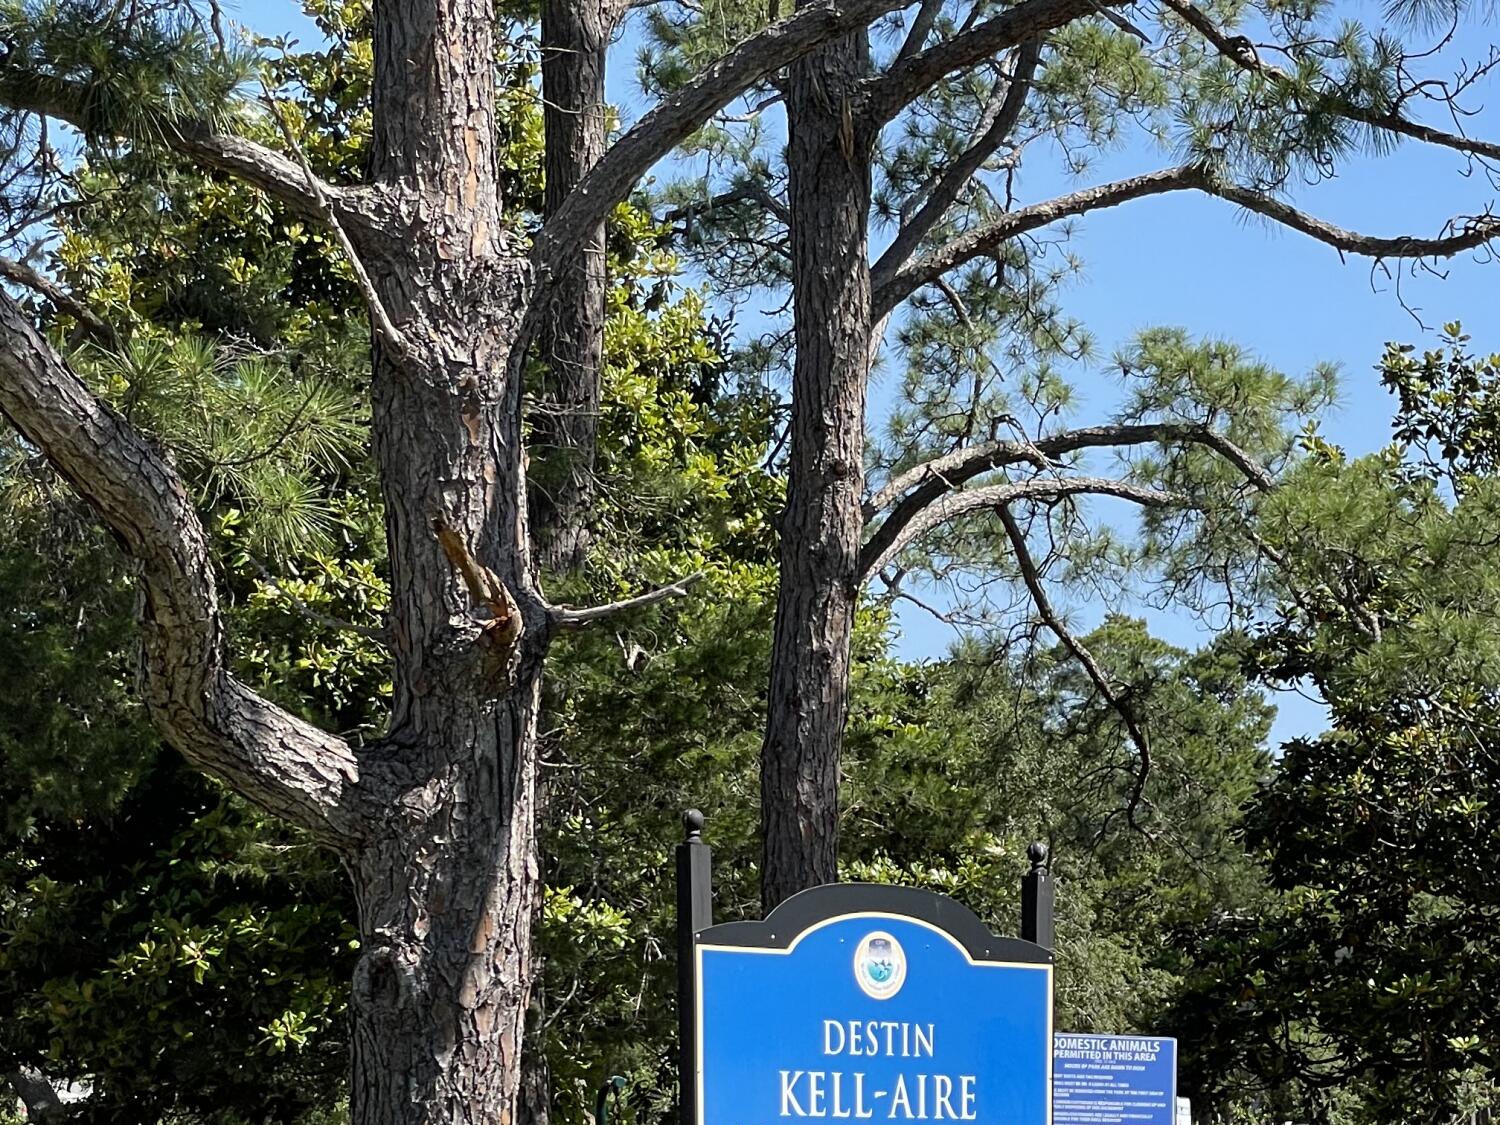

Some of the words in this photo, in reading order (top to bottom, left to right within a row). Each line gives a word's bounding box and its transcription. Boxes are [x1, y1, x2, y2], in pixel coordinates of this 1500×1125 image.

[822, 1019, 935, 1057] DESTIN
[1109, 1040, 1161, 1053] ANIMALS
[1053, 1048, 1101, 1060] PERMITTED
[1102, 1051, 1112, 1060] IN
[1113, 1052, 1133, 1061] THIS
[1134, 1052, 1156, 1062] AREA
[778, 1070, 978, 1120] KELL-AIRE
